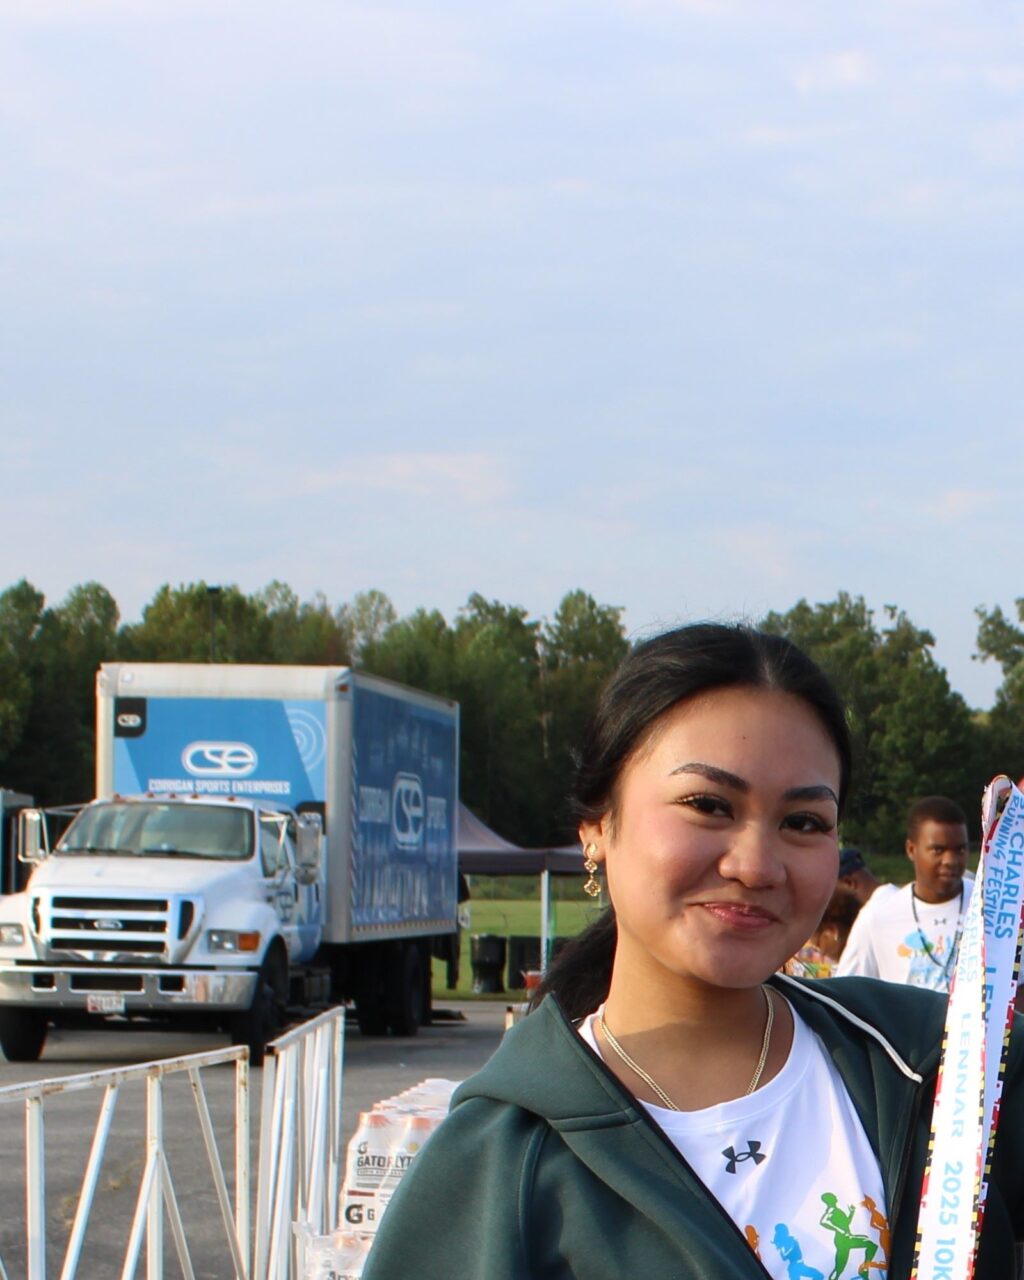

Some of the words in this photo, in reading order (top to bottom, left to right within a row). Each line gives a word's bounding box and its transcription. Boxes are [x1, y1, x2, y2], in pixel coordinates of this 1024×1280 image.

[195, 780, 230, 794] SPORTS
[232, 781, 290, 795] ENTERPRISES
[951, 1013, 972, 1137] LENNAR
[939, 1160, 964, 1226] 2025
